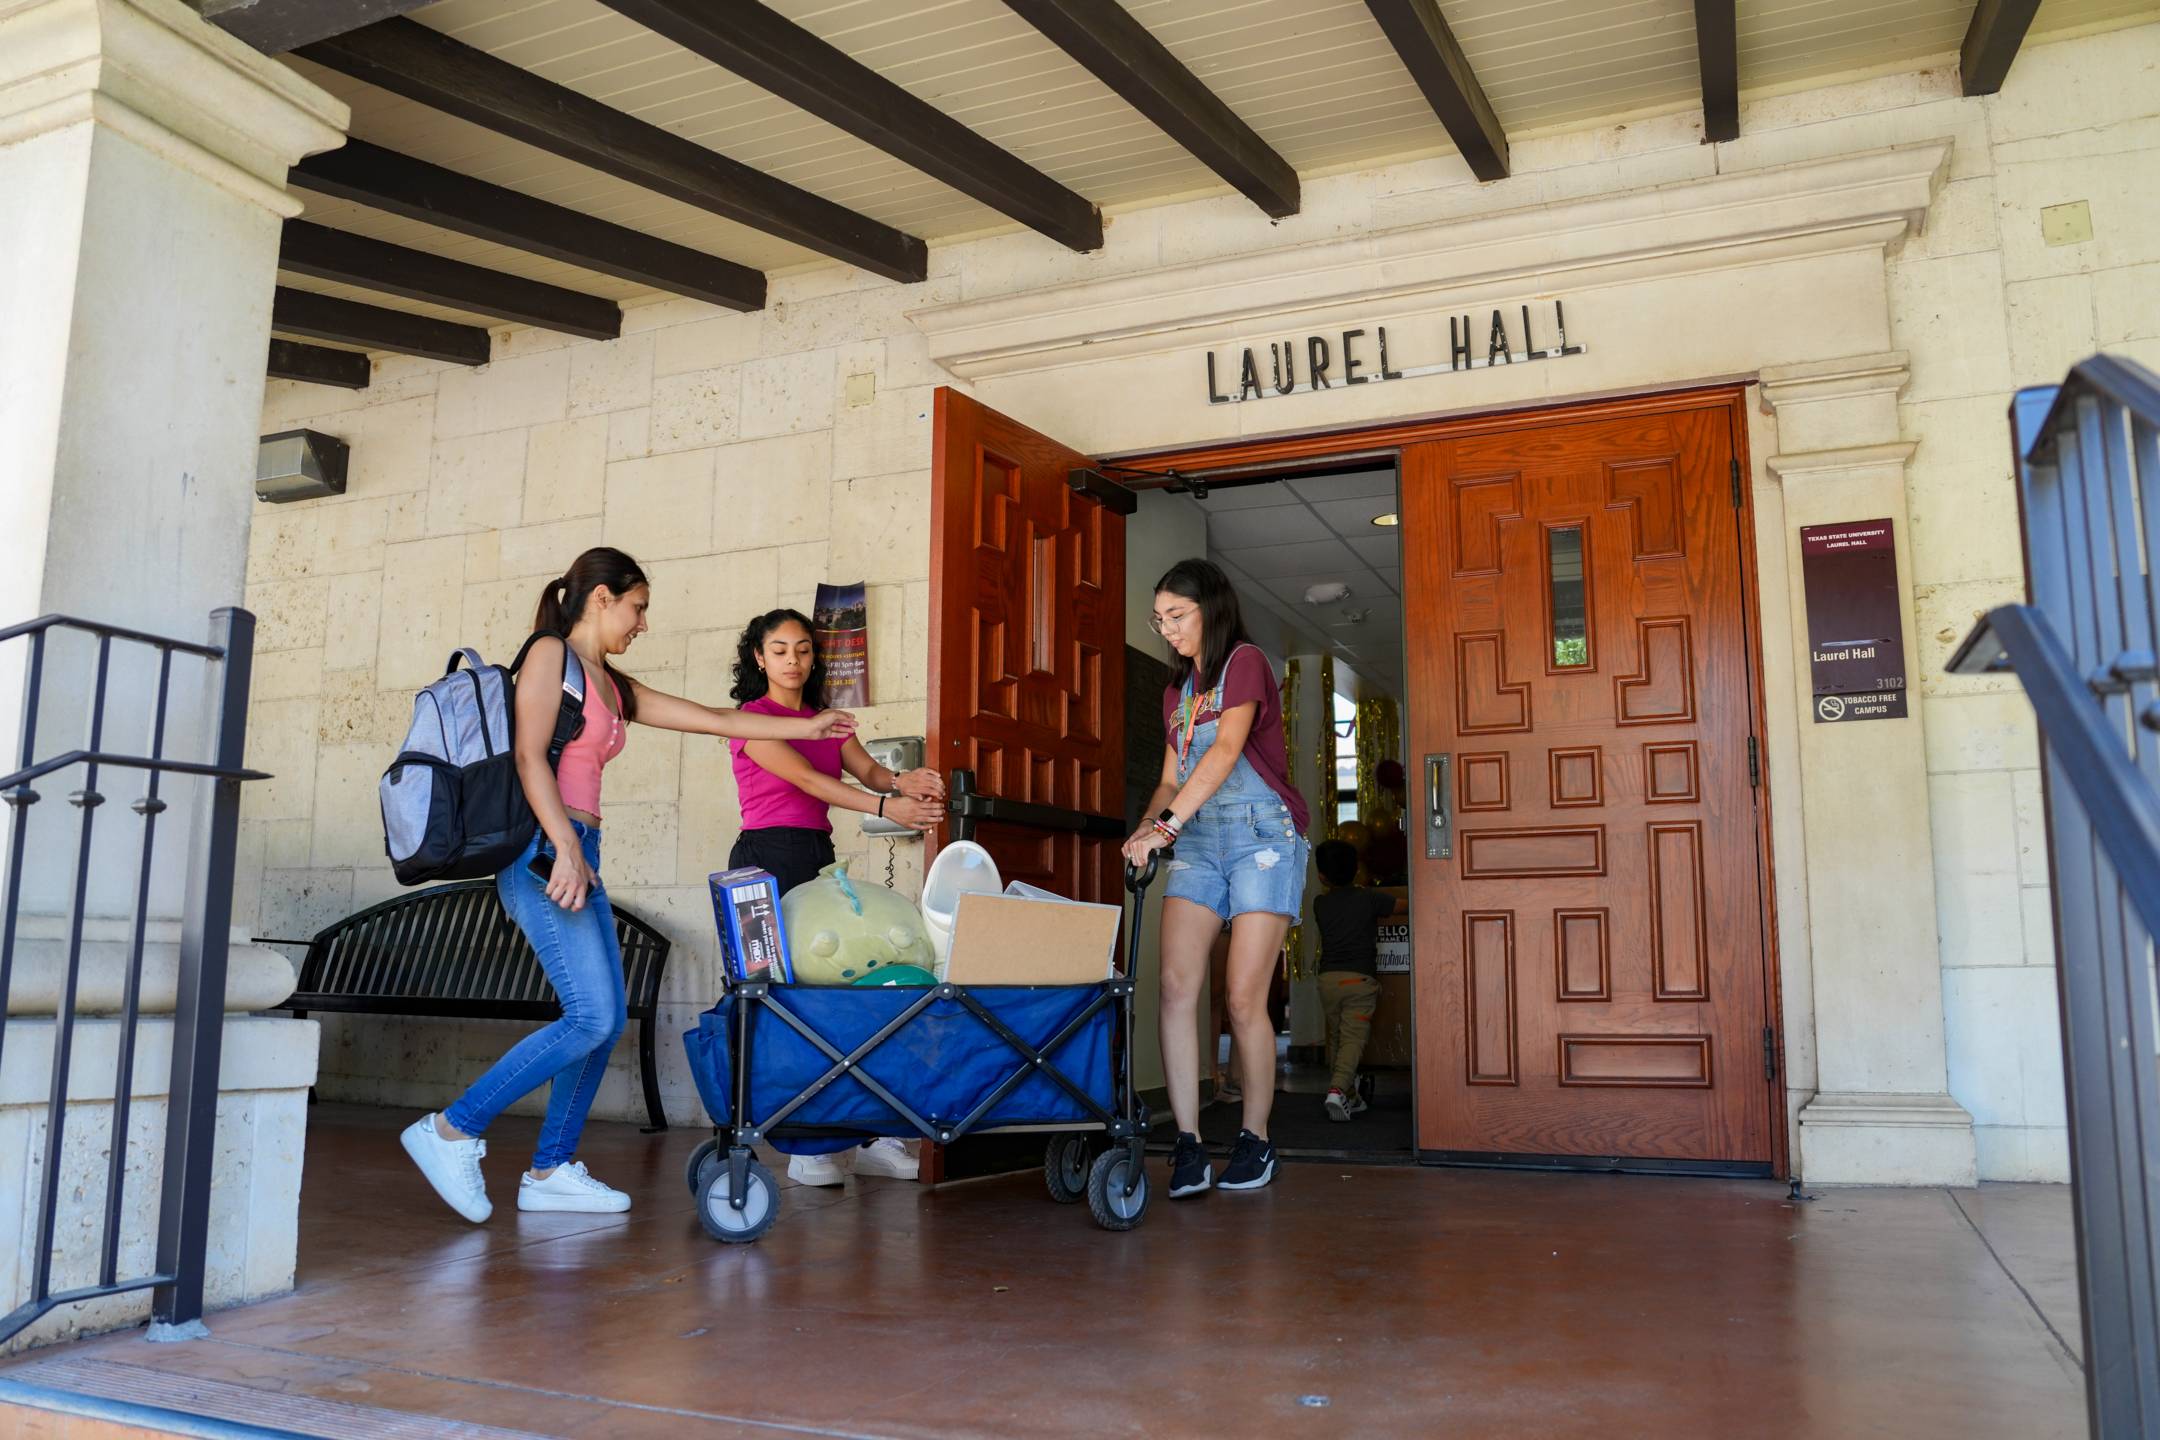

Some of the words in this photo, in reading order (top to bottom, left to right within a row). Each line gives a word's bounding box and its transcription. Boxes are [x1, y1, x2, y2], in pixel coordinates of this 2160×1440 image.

[1207, 327, 1403, 403] LAUREL
[1450, 299, 1582, 371] HALL
[1848, 529, 1885, 538] UNIVERSITY
[1826, 540, 1849, 548] LAUREL
[1813, 649, 1849, 662] Laurel
[1852, 647, 1875, 660] Hall
[1876, 676, 1903, 689] 3102
[1843, 695, 1877, 705] TOBACCO
[1878, 693, 1897, 702] FREE
[1854, 705, 1888, 715] CAMPUS
[1378, 925, 1408, 937] ELLO
[751, 939, 762, 963] max
